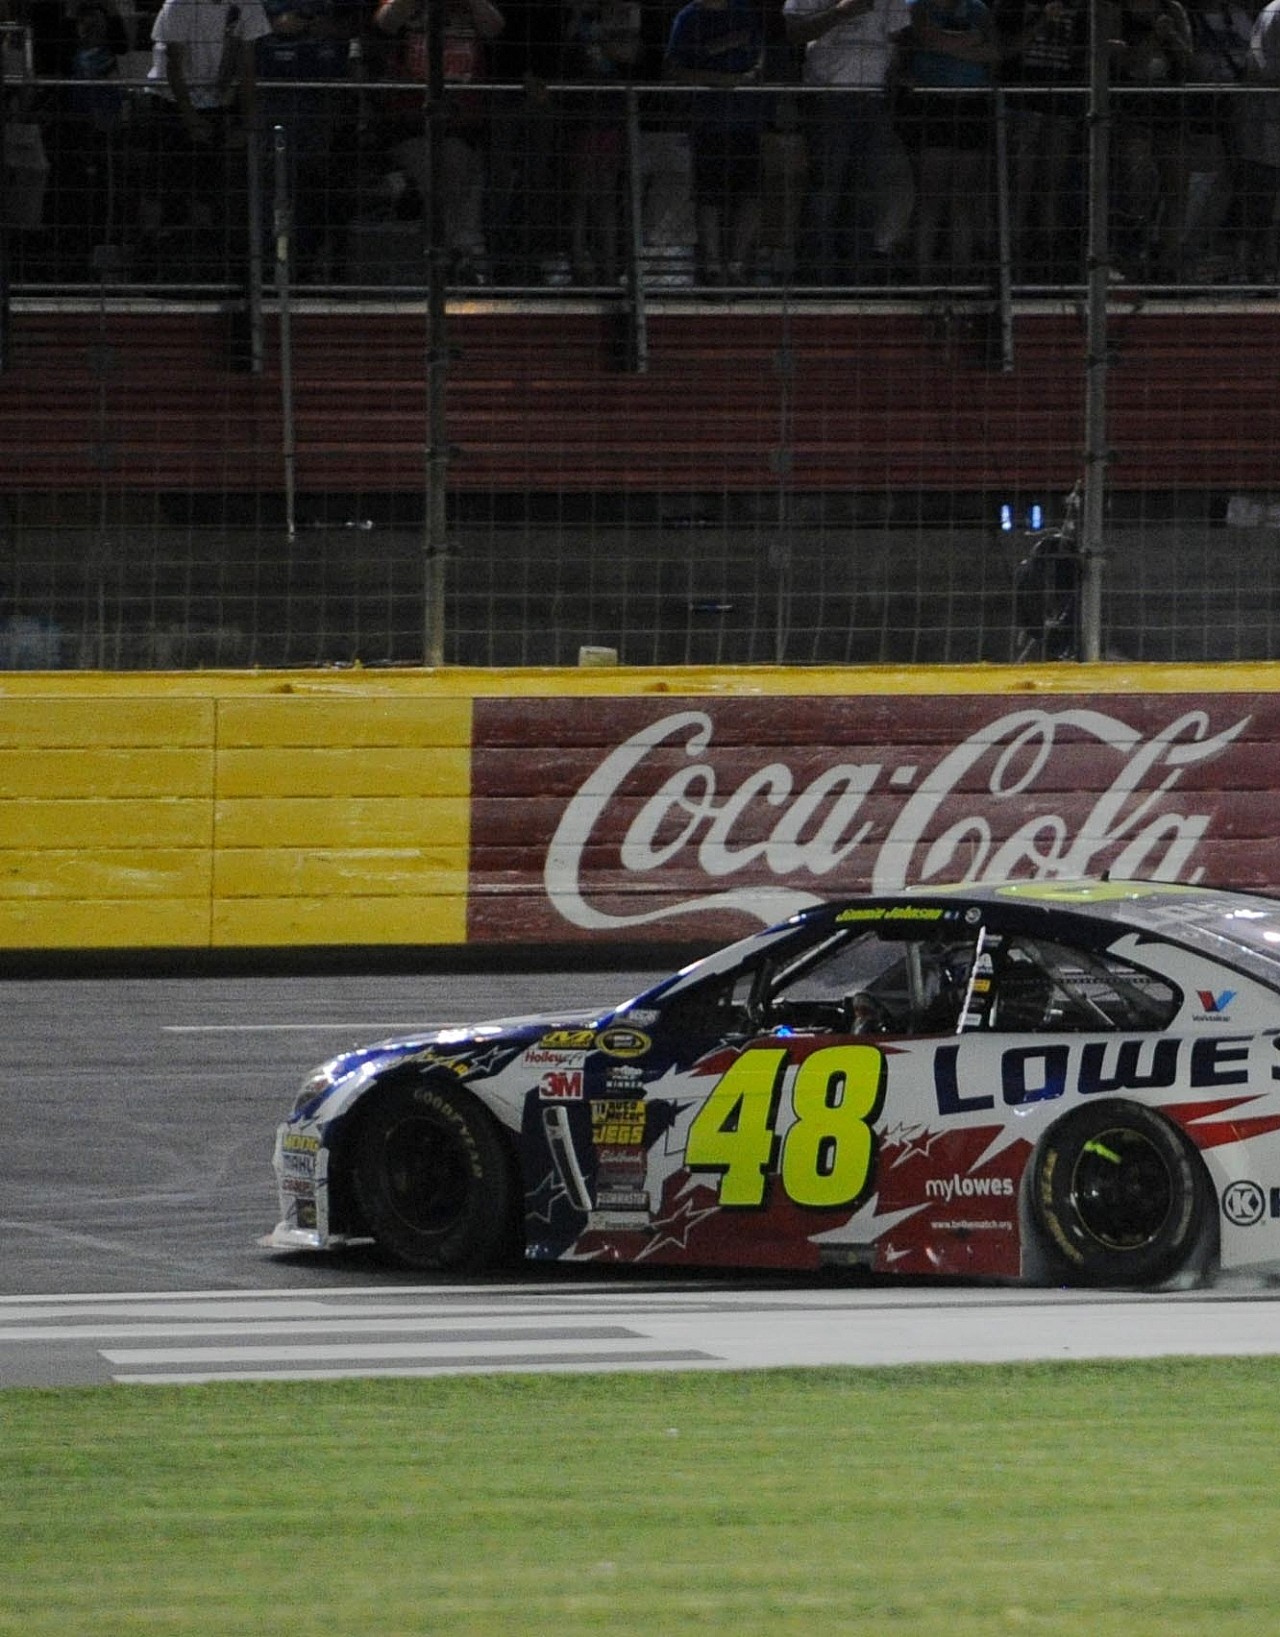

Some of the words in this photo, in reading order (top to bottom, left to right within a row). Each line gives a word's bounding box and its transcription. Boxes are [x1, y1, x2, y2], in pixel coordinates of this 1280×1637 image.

[544, 709, 1252, 929] Coca-Cola
[540, 1071, 581, 1097] 3M
[684, 1045, 887, 1206] 48
[925, 1173, 1014, 1201] mylowes
